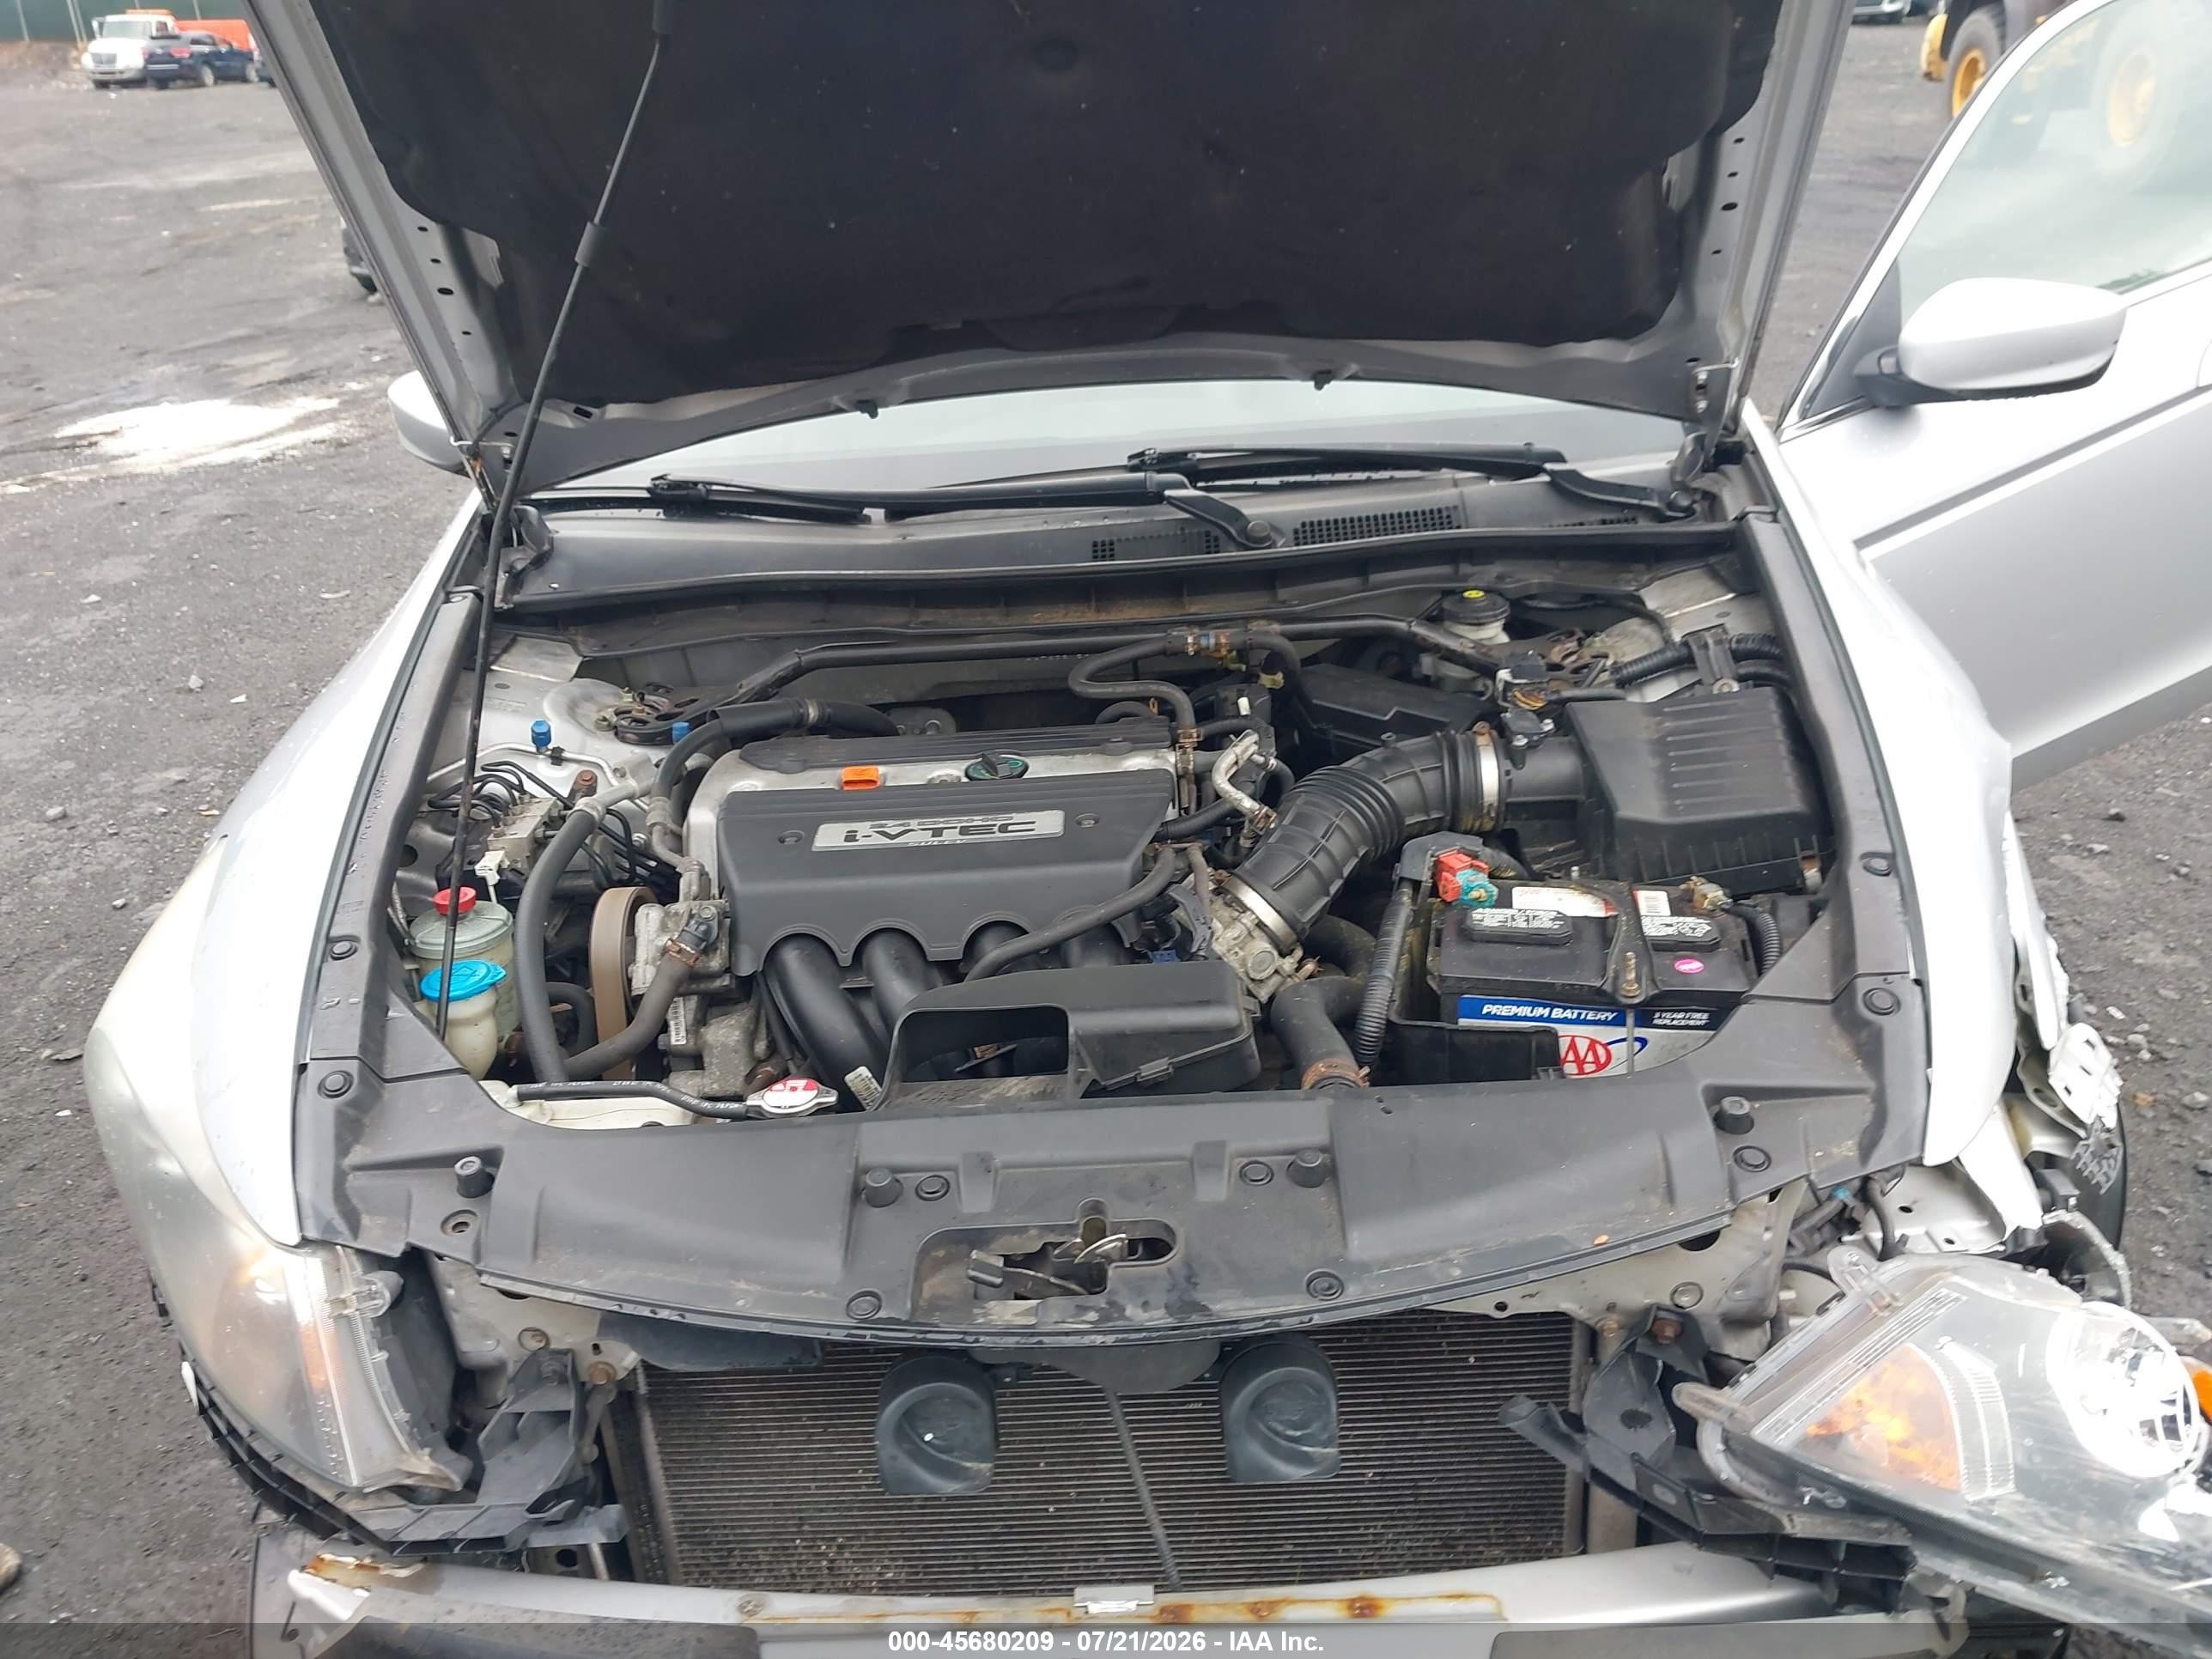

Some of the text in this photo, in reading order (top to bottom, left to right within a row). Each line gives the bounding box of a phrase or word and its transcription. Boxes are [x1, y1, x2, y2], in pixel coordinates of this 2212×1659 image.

[843, 821, 1037, 843] i-VTEC
[1481, 1004, 1618, 1022] PREMIUM BATTERY
[1559, 1036, 1604, 1075] AA
